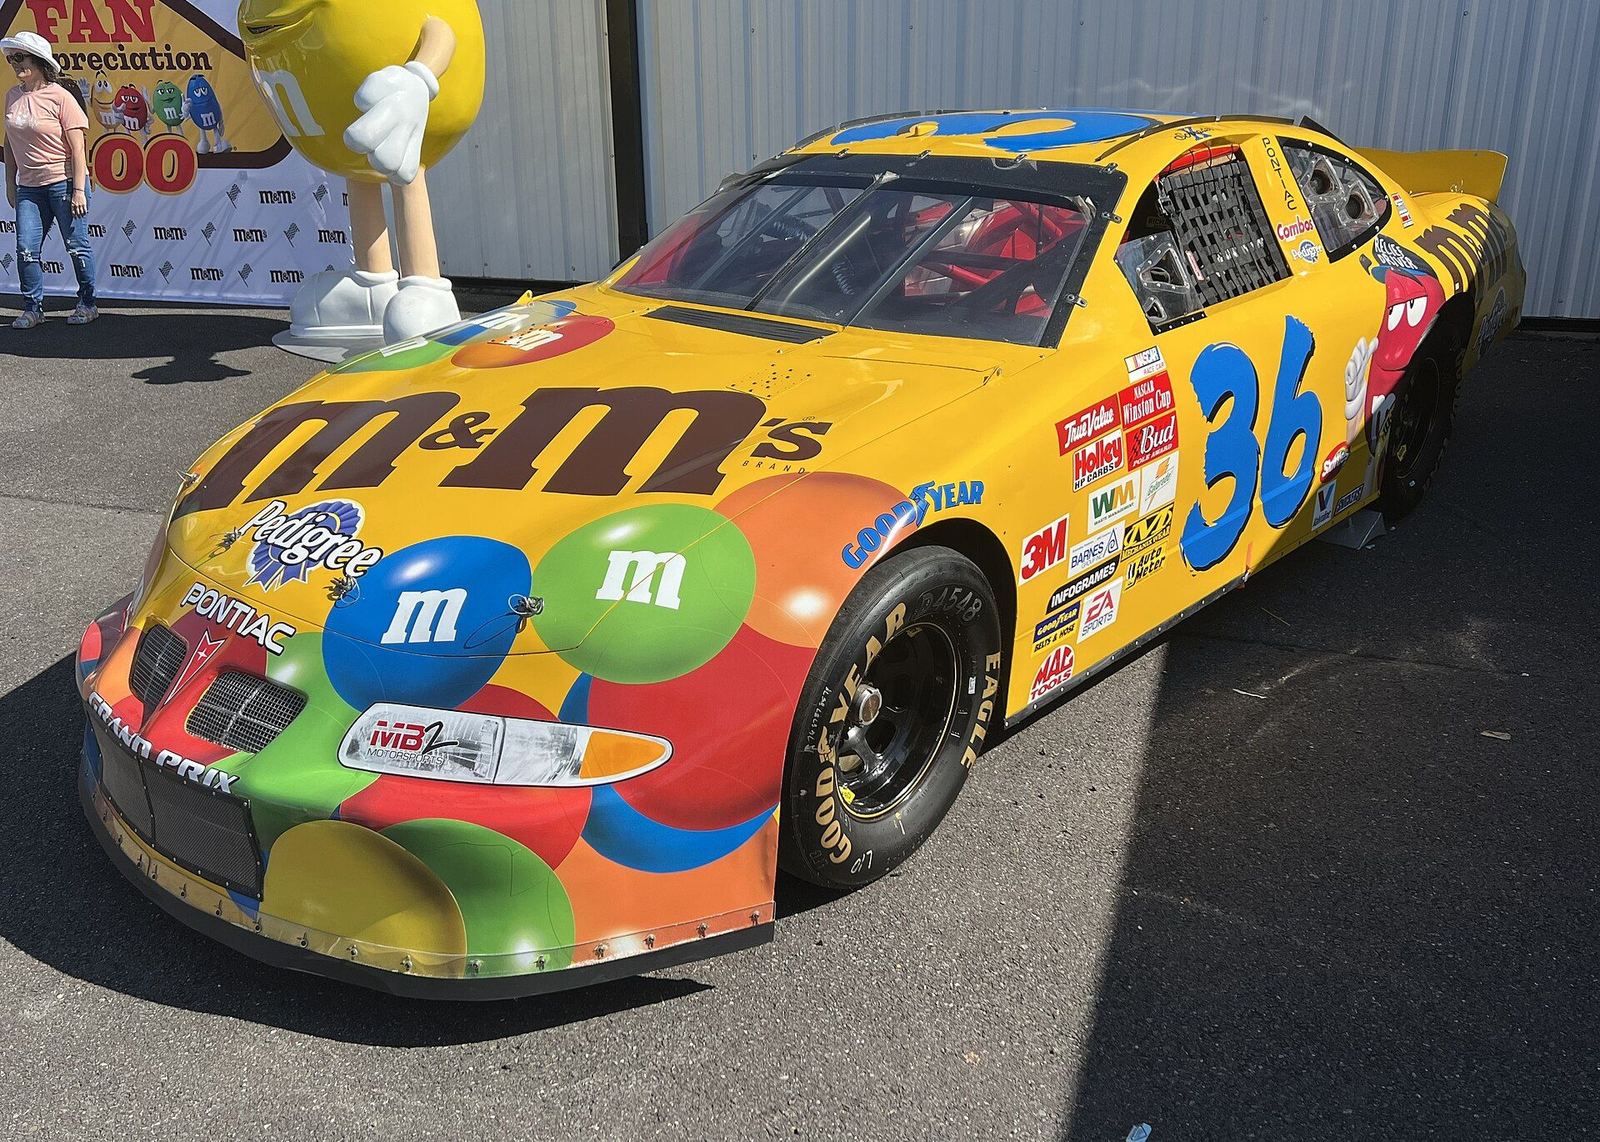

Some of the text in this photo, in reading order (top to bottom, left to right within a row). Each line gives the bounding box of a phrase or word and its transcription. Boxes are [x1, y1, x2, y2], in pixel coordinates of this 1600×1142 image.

[26, 0, 156, 43] FAN
[53, 44, 212, 71] preciation
[88, 135, 197, 193] 00
[1262, 138, 1298, 211] PONTIAC
[1276, 215, 1313, 240] Combos
[1374, 236, 1405, 258] RELIEF
[1377, 253, 1418, 270] DRIVER
[1123, 389, 1171, 425] Winston Cup
[1133, 379, 1155, 401] NASCAR
[1140, 414, 1176, 455] Bud
[1179, 315, 1323, 571] 36
[742, 460, 806, 475] BRAND
[1074, 436, 1123, 481] Holley
[1132, 443, 1173, 468] POLE AWARD
[1074, 462, 1114, 490] HP CARBS
[1092, 479, 1135, 519] WM
[240, 499, 384, 580] Pedigree
[841, 479, 985, 570] GOODYEAR
[1021, 517, 1068, 581] 3M
[1070, 541, 1104, 569] BARNES
[1137, 546, 1163, 569] Auto
[1050, 561, 1116, 608] INFOGRAMES
[1136, 555, 1166, 581] Meter
[181, 582, 297, 655] PONTIAC
[1036, 607, 1078, 636] GOODYEAR
[1081, 610, 1114, 637] SPORTS
[1084, 588, 1114, 625] EA
[1034, 634, 1052, 653] BELTS
[1059, 623, 1076, 640] HOSE
[1030, 669, 1072, 701] TOOLS
[1031, 645, 1074, 691] MAC
[89, 691, 153, 759] GRAND
[960, 651, 1001, 769] EAGLE
[155, 749, 240, 794] PRIX
[366, 747, 445, 766] MOTORSPORTS
